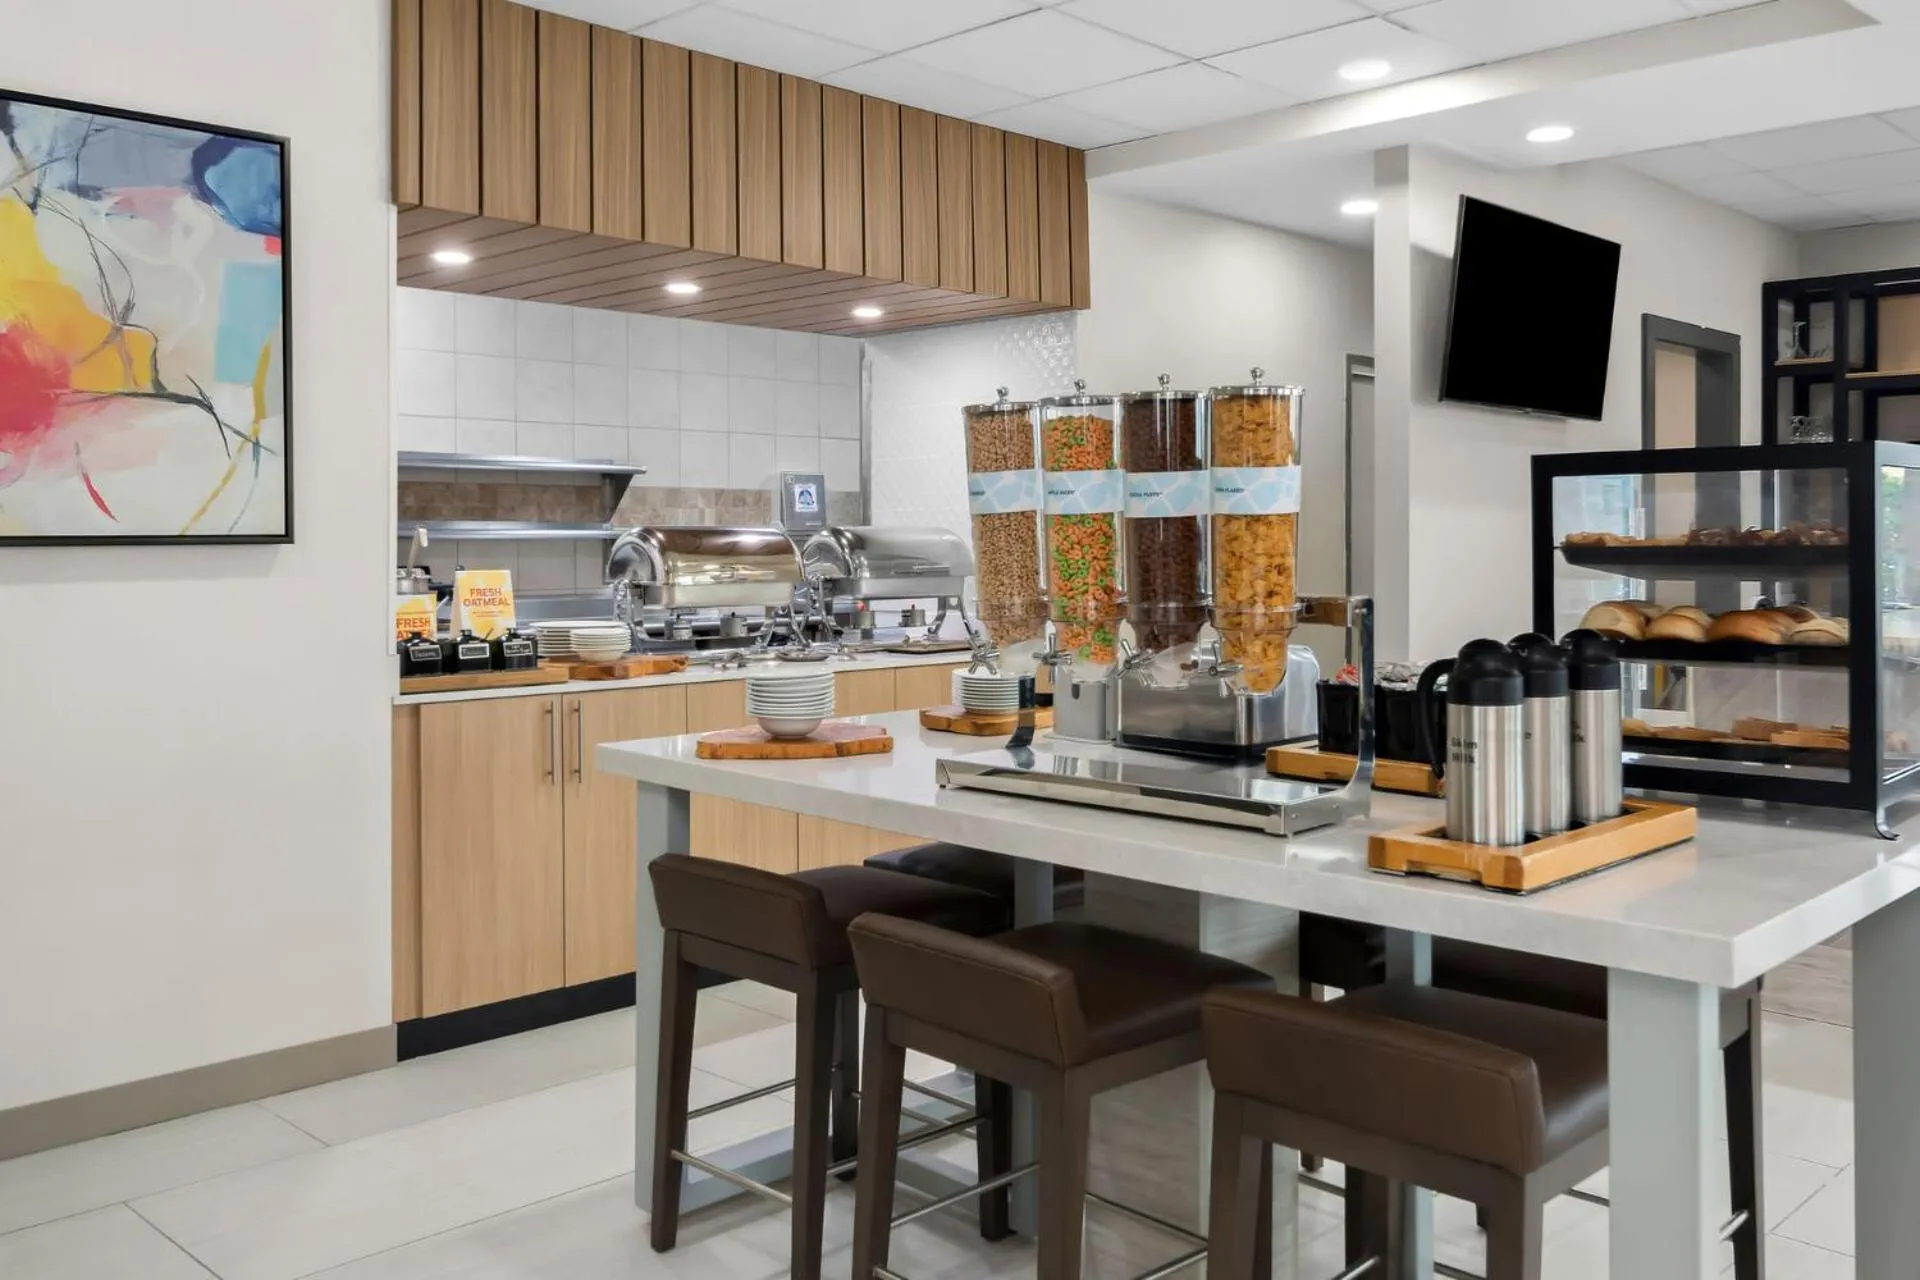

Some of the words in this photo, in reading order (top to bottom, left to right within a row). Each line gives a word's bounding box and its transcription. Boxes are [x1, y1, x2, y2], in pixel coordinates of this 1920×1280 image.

[470, 588, 501, 597] FRESH
[463, 598, 511, 606] OATMEAL
[396, 618, 430, 628] FRESH
